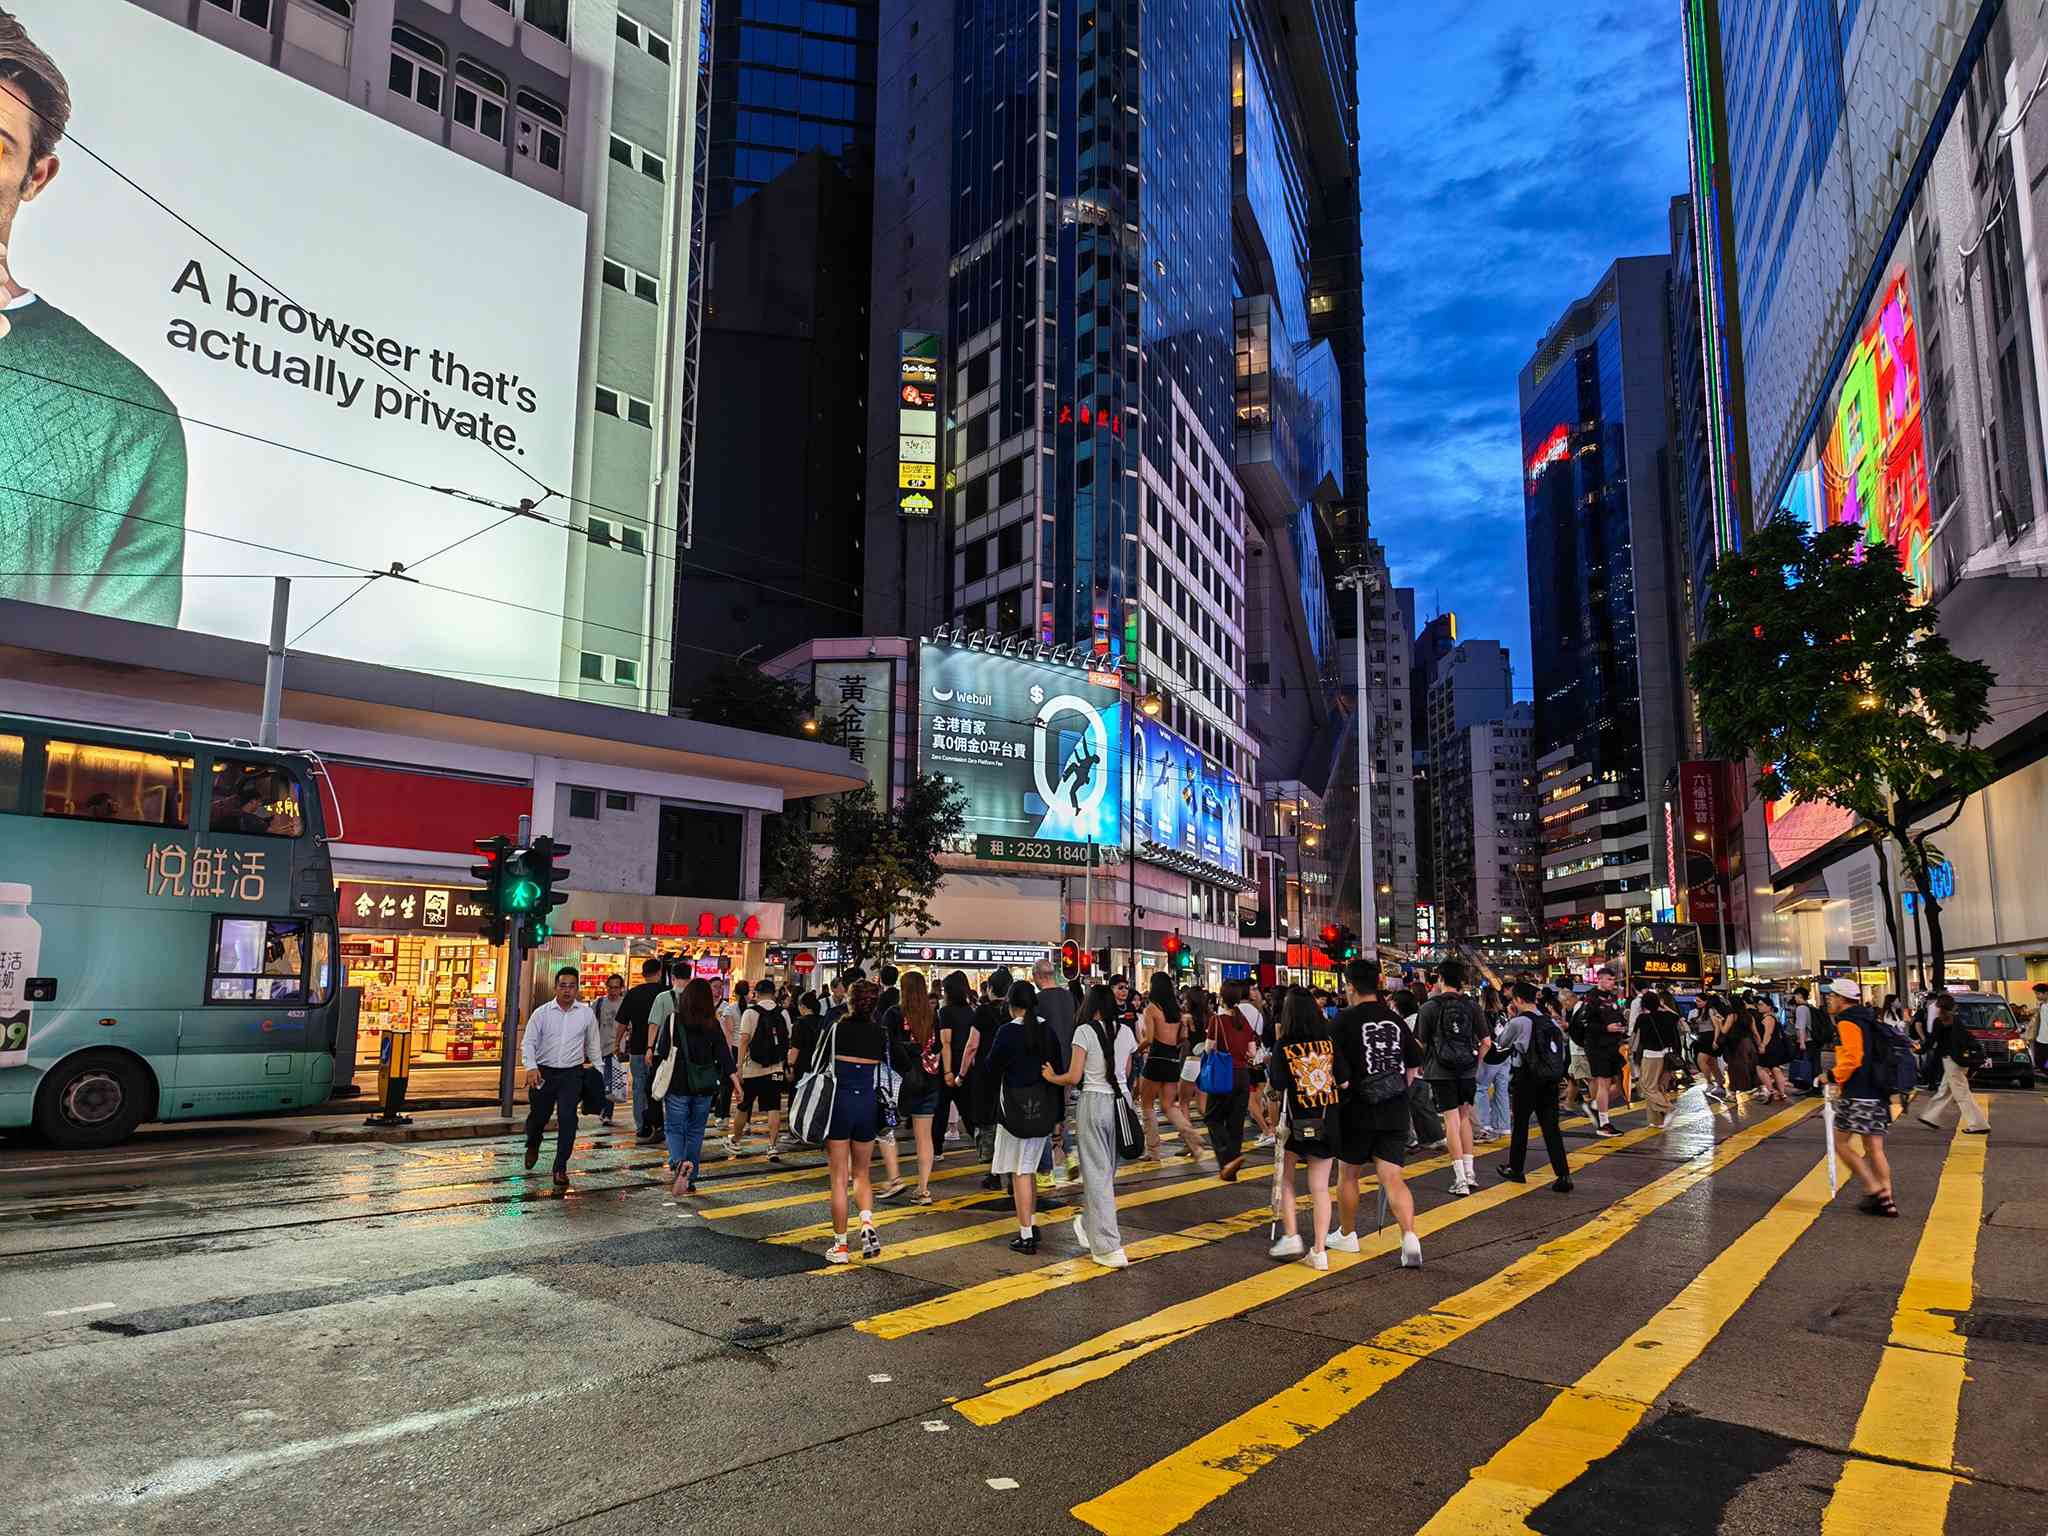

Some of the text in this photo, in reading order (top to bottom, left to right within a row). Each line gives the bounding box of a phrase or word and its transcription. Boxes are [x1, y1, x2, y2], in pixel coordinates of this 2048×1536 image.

[171, 260, 538, 413] A browser that's
[166, 317, 525, 455] actually private.
[956, 690, 992, 706] Webull
[932, 715, 986, 735] 全港首家
[932, 734, 1026, 759] 真0佣金0平台費
[1017, 842, 1051, 859] 2523
[1055, 846, 1088, 862] 1840
[145, 843, 266, 901] 悅鮮活
[354, 891, 416, 920] 余仁生
[455, 903, 469, 917] Eu
